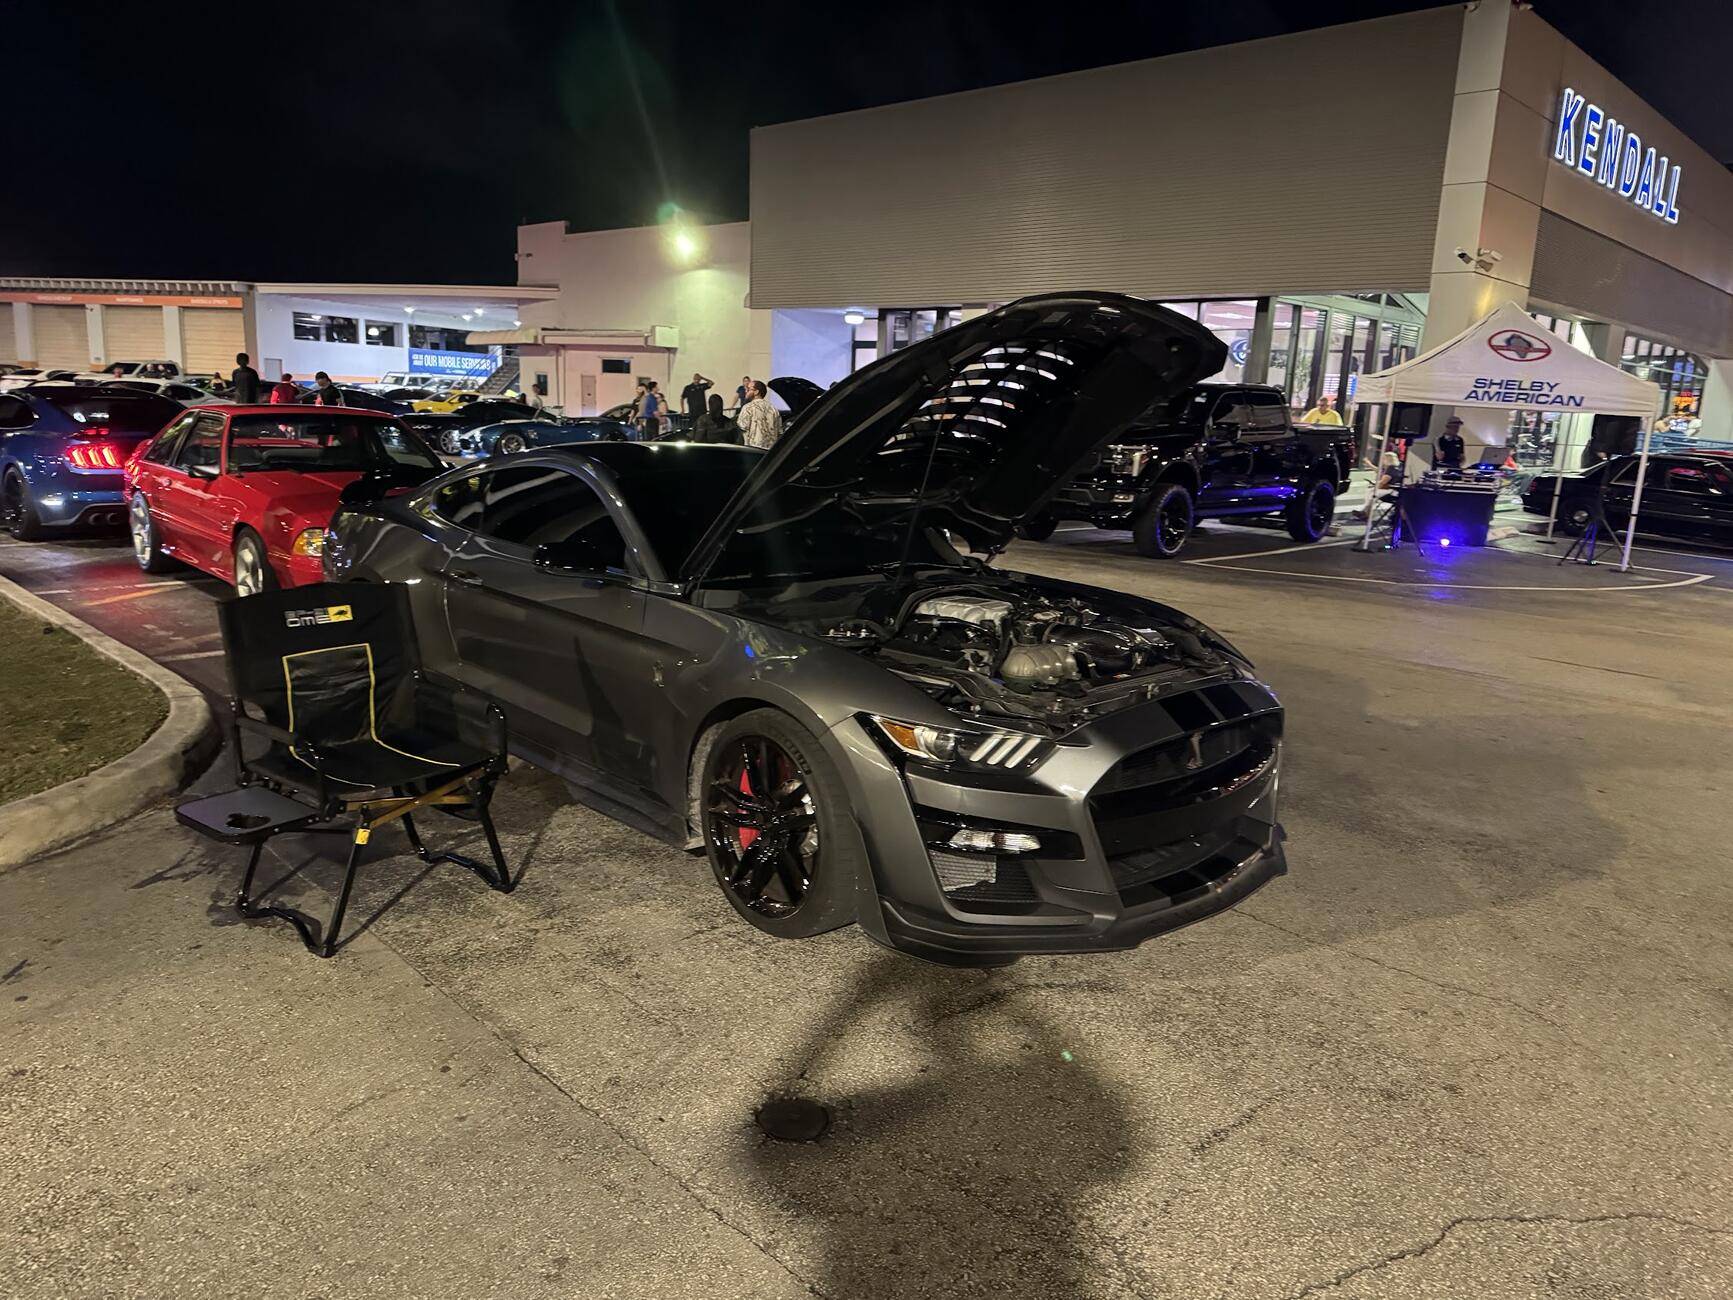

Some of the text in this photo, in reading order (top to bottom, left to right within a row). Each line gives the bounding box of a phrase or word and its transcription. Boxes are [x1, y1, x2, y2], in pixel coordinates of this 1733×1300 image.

[1554, 87, 1682, 225] KENDALL
[424, 354, 438, 367] OUR
[438, 355, 461, 368] MOBILE
[1473, 378, 1561, 393] SHELBY
[1464, 389, 1585, 407] AMERICAN
